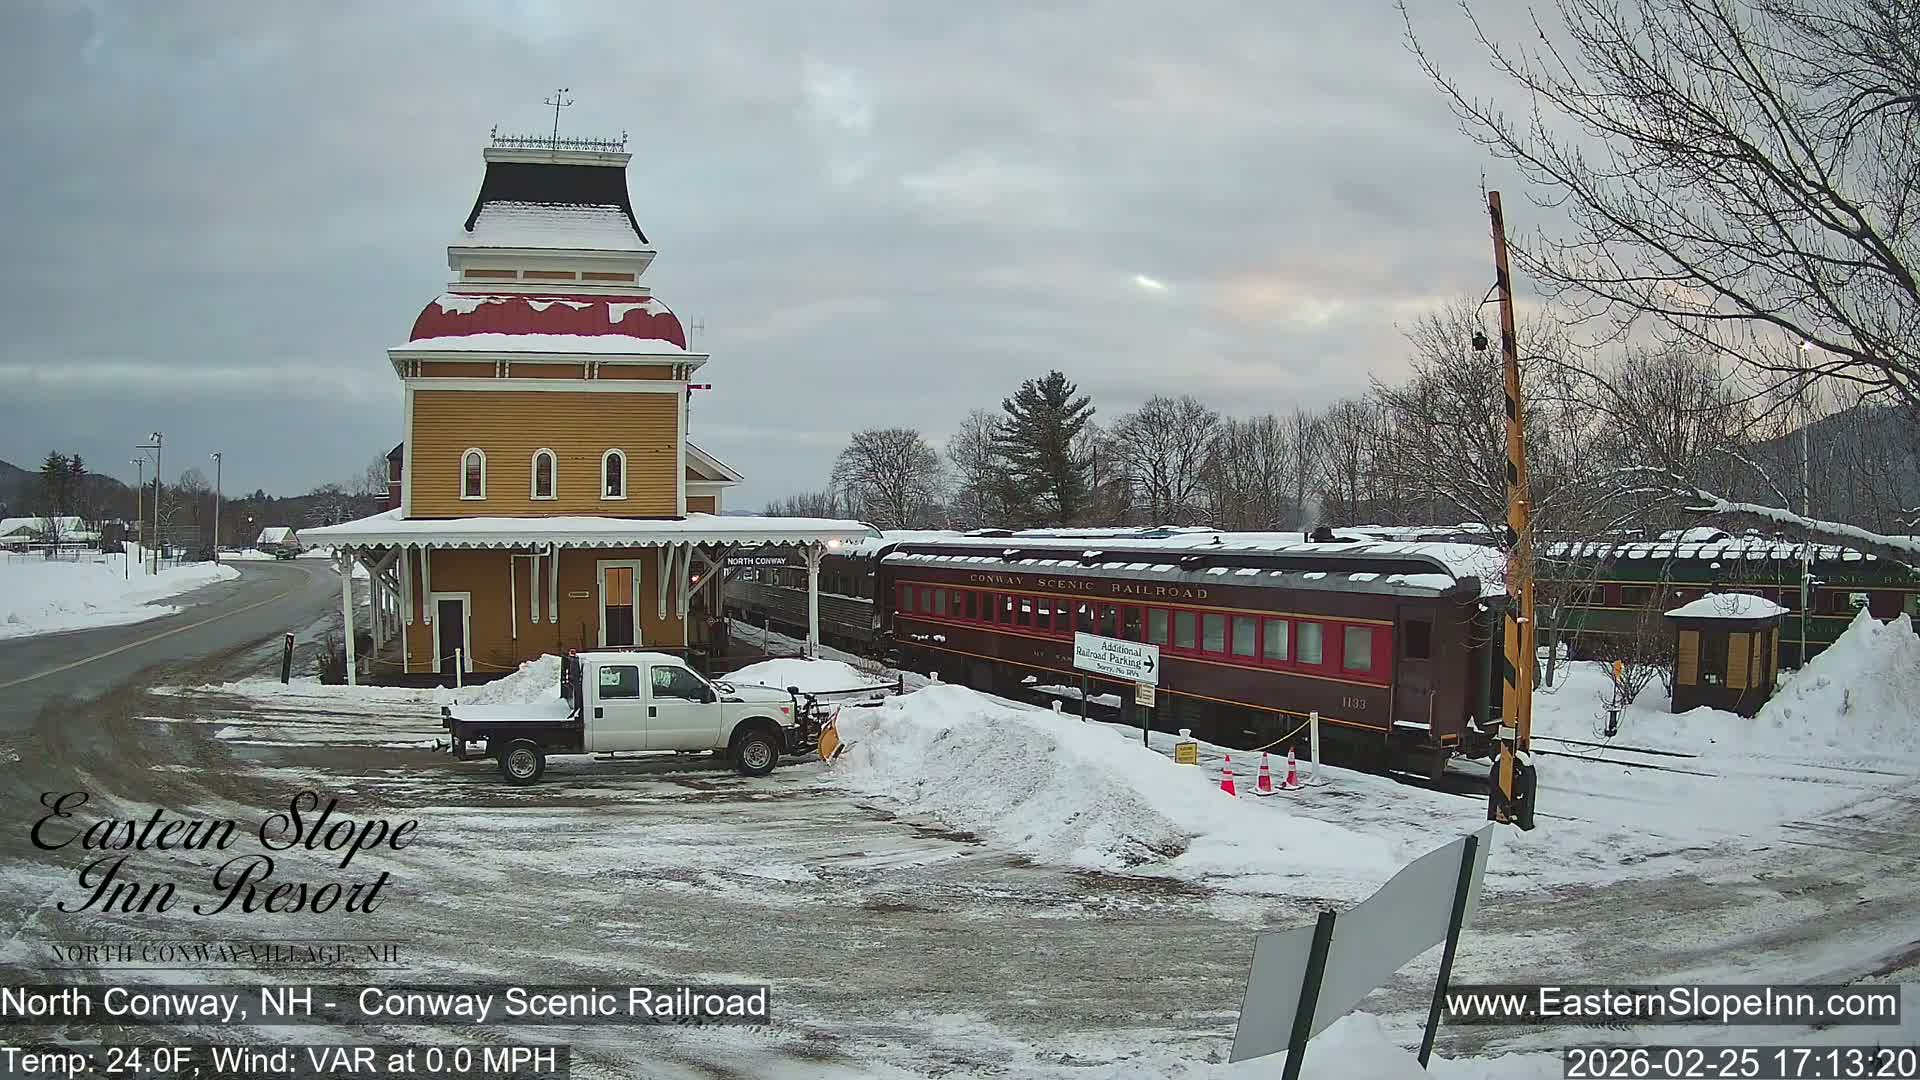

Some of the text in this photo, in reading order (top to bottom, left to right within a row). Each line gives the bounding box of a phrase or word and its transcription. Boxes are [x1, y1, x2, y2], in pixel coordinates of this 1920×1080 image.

[727, 557, 786, 565] NORTH CONWAY
[970, 574, 1208, 600] CONWAY SCENIC RAILROAD
[1101, 641, 1142, 657] Additional
[1076, 646, 1107, 661] Railroad
[1109, 653, 1142, 670] Parking
[1115, 667, 1125, 675] No
[1126, 668, 1140, 678] RVs
